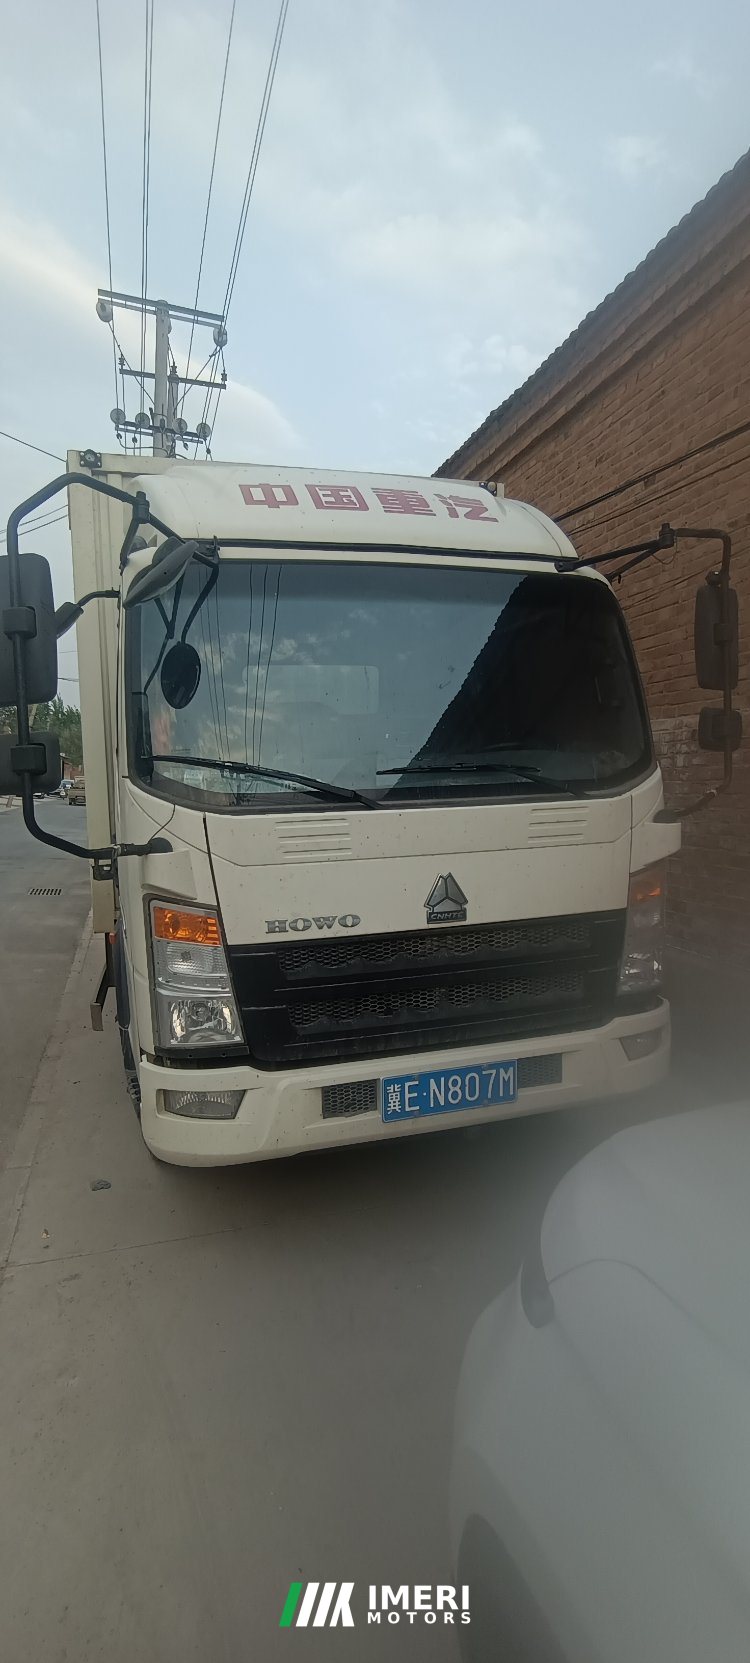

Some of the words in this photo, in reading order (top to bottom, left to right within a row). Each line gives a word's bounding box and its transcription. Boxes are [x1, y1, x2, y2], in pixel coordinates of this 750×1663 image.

[239, 483, 499, 522] 中国重汽
[265, 914, 361, 934] HOWO
